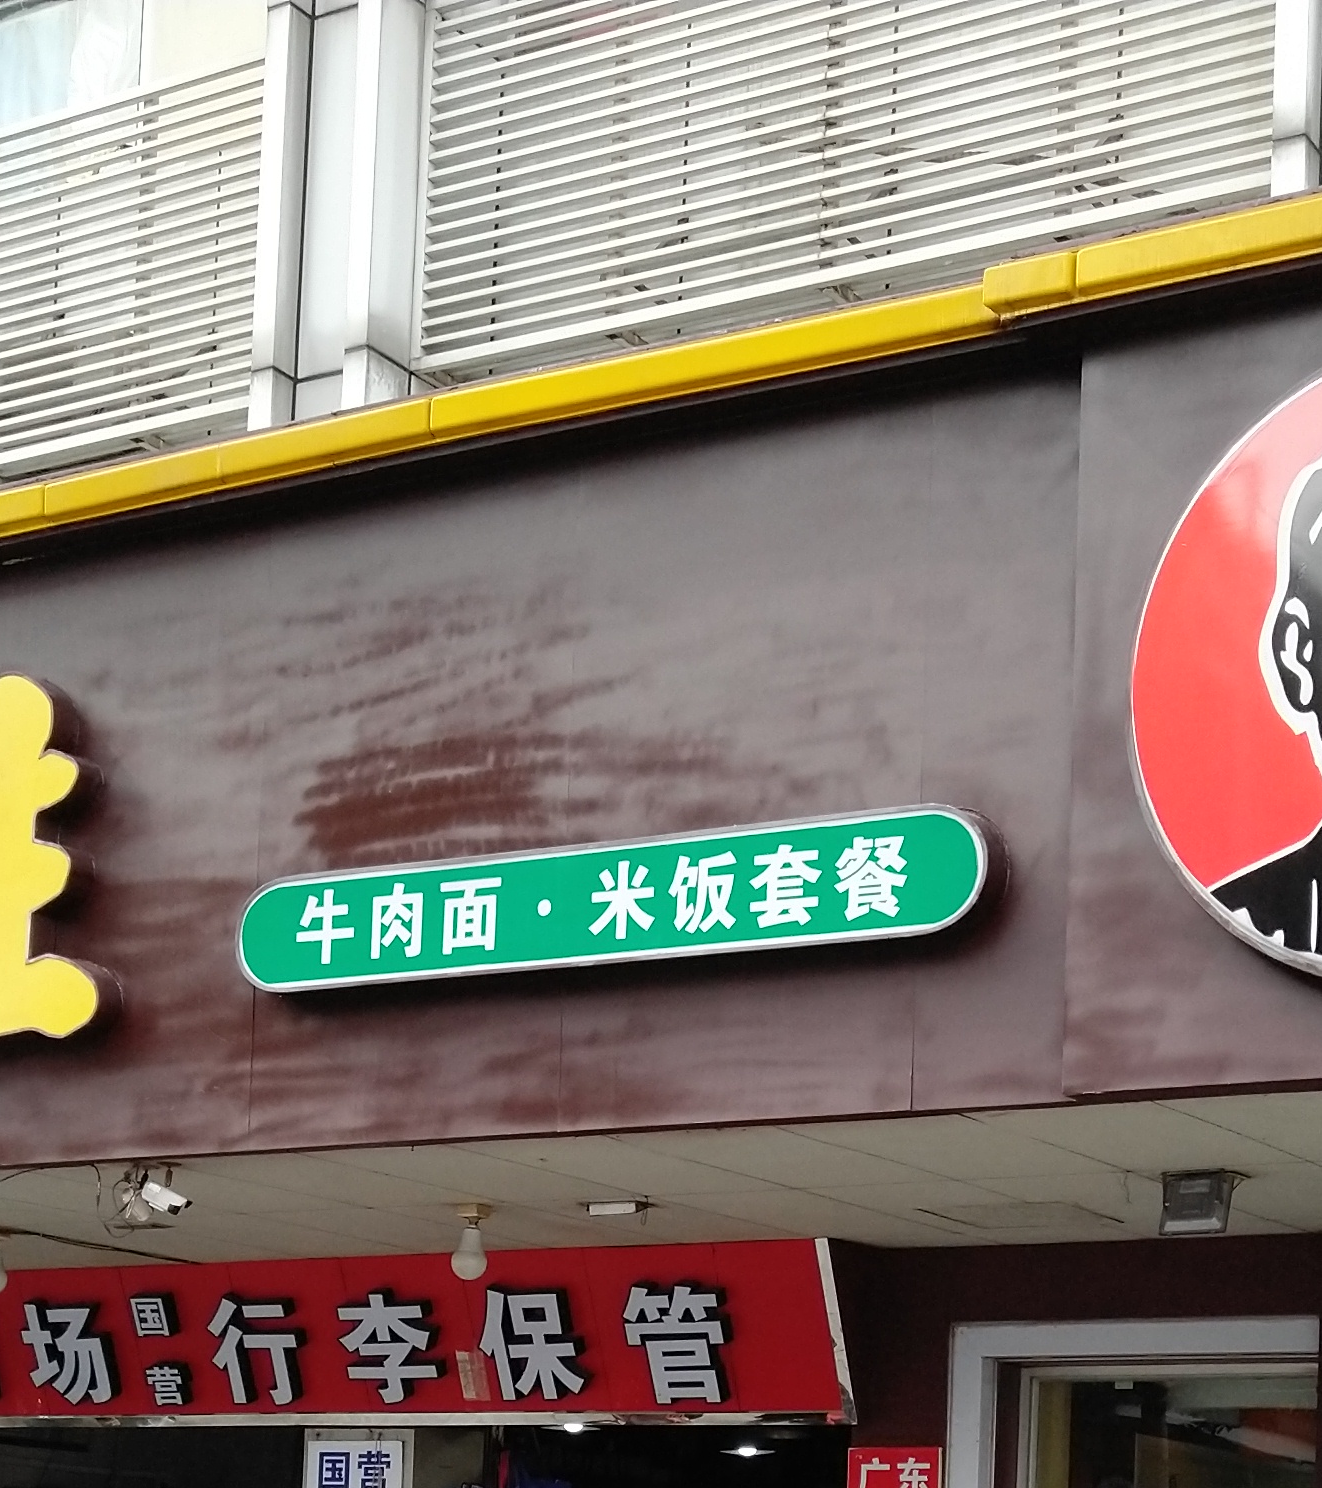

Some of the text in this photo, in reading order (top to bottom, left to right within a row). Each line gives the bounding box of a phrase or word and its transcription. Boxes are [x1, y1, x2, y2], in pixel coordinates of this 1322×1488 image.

[129, 1295, 183, 1406] 国营
[206, 1284, 728, 1405] 行李保管
